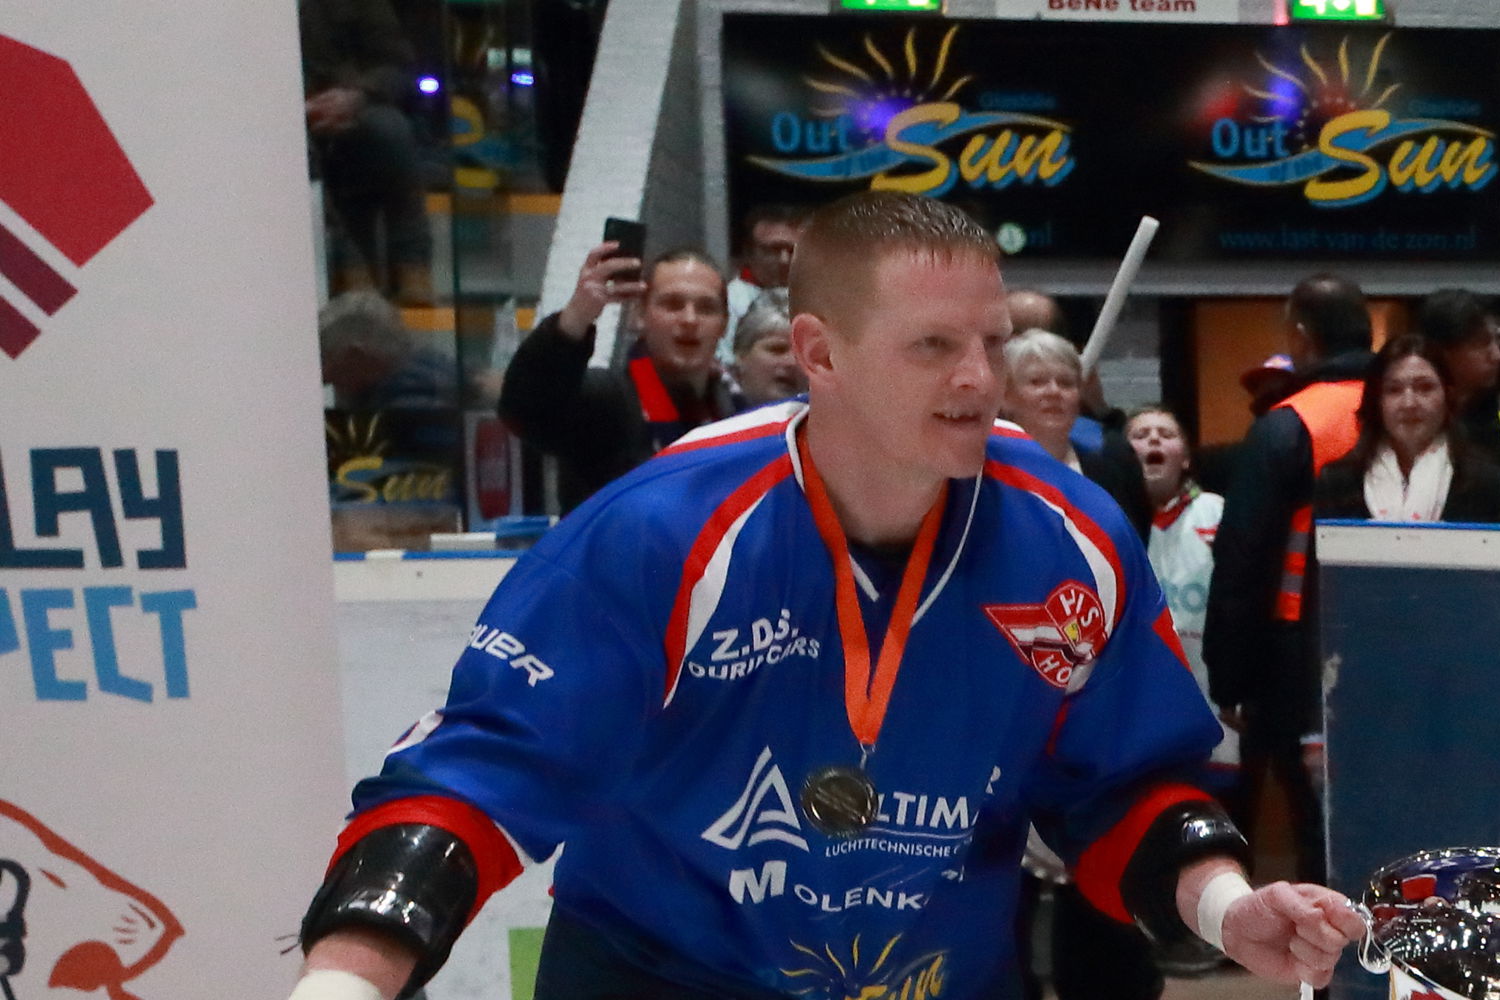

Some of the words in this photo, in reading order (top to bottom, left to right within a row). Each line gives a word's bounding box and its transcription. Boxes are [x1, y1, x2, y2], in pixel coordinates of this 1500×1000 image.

[1131, 0, 1198, 13] team
[767, 112, 852, 152] Out
[870, 102, 1076, 196] Sun
[1211, 118, 1293, 158] Out
[1304, 109, 1498, 208] Sun
[710, 608, 799, 661] Z.DS.
[728, 859, 930, 913] MOLENK
